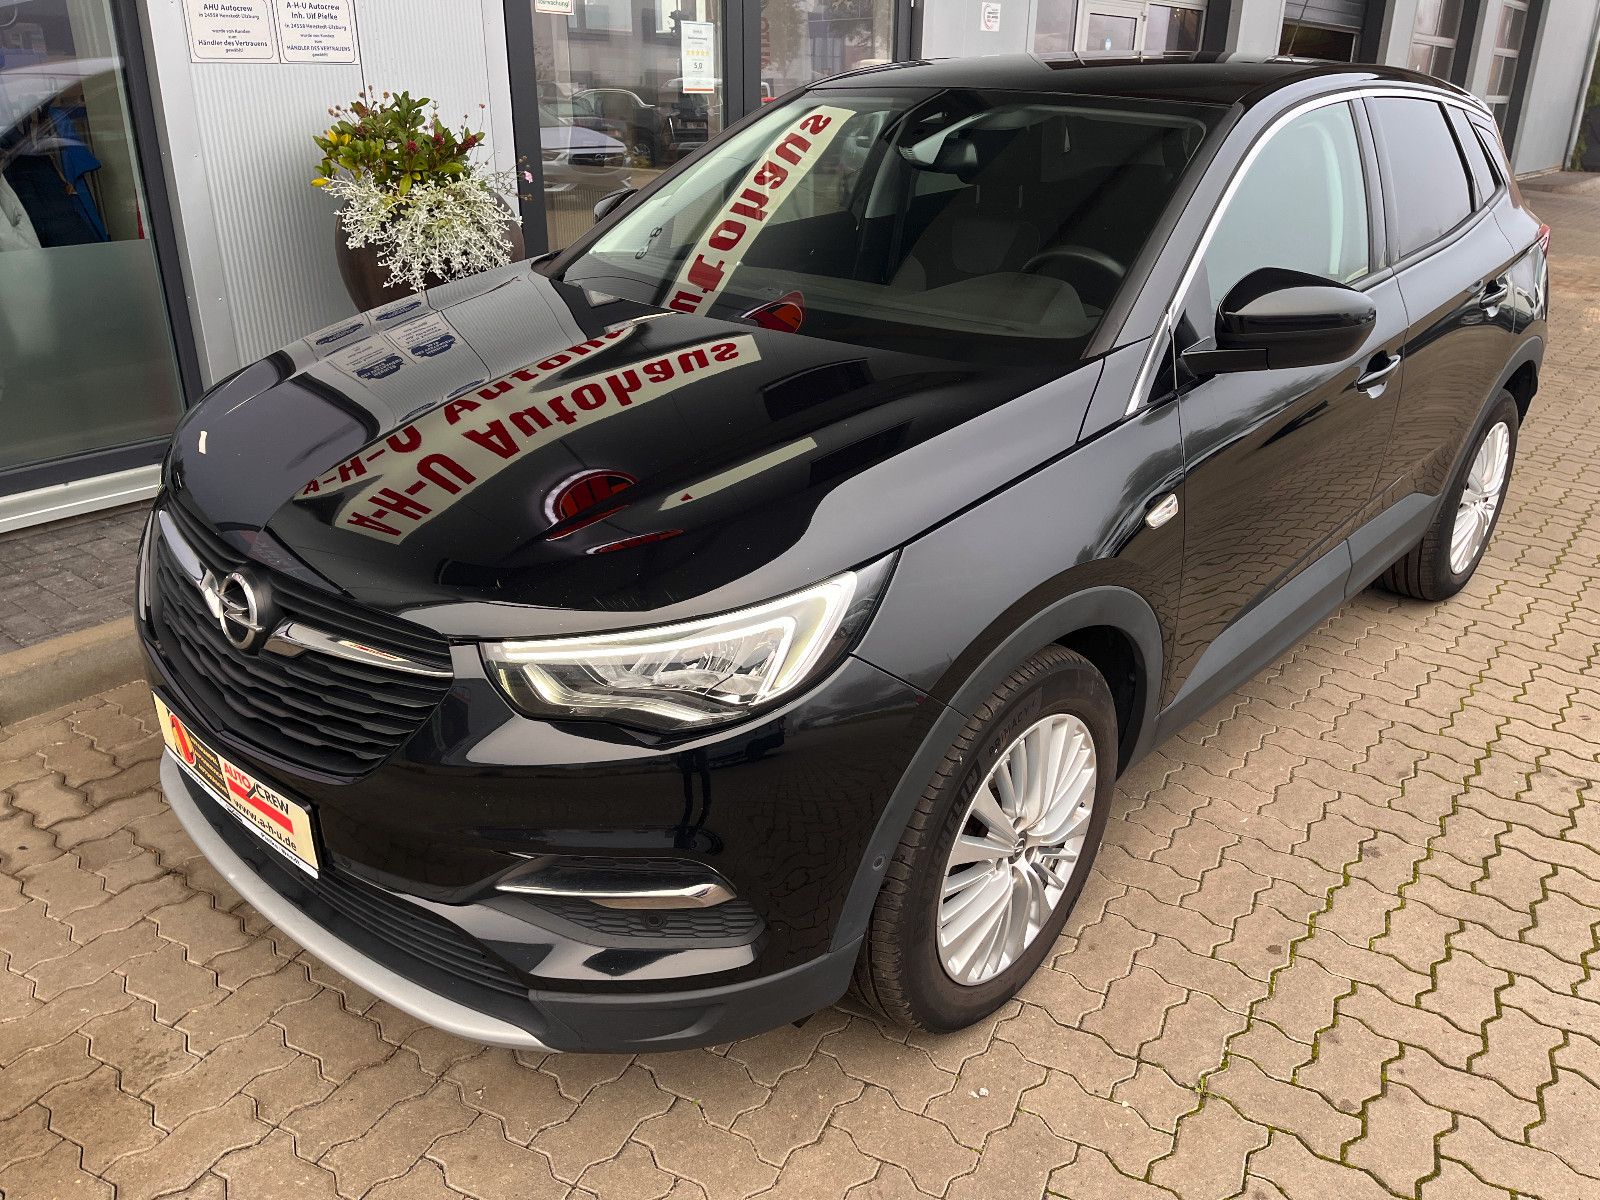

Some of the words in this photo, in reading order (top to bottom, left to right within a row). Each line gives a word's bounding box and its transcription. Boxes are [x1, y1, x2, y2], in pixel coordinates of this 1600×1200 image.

[203, 3, 219, 11] AHU
[220, 4, 253, 12] Autocrew
[308, 2, 340, 11] Autocrew
[224, 763, 251, 789] AUTO
[256, 783, 289, 815] CREW
[234, 800, 297, 851] www.a-h-u.de
